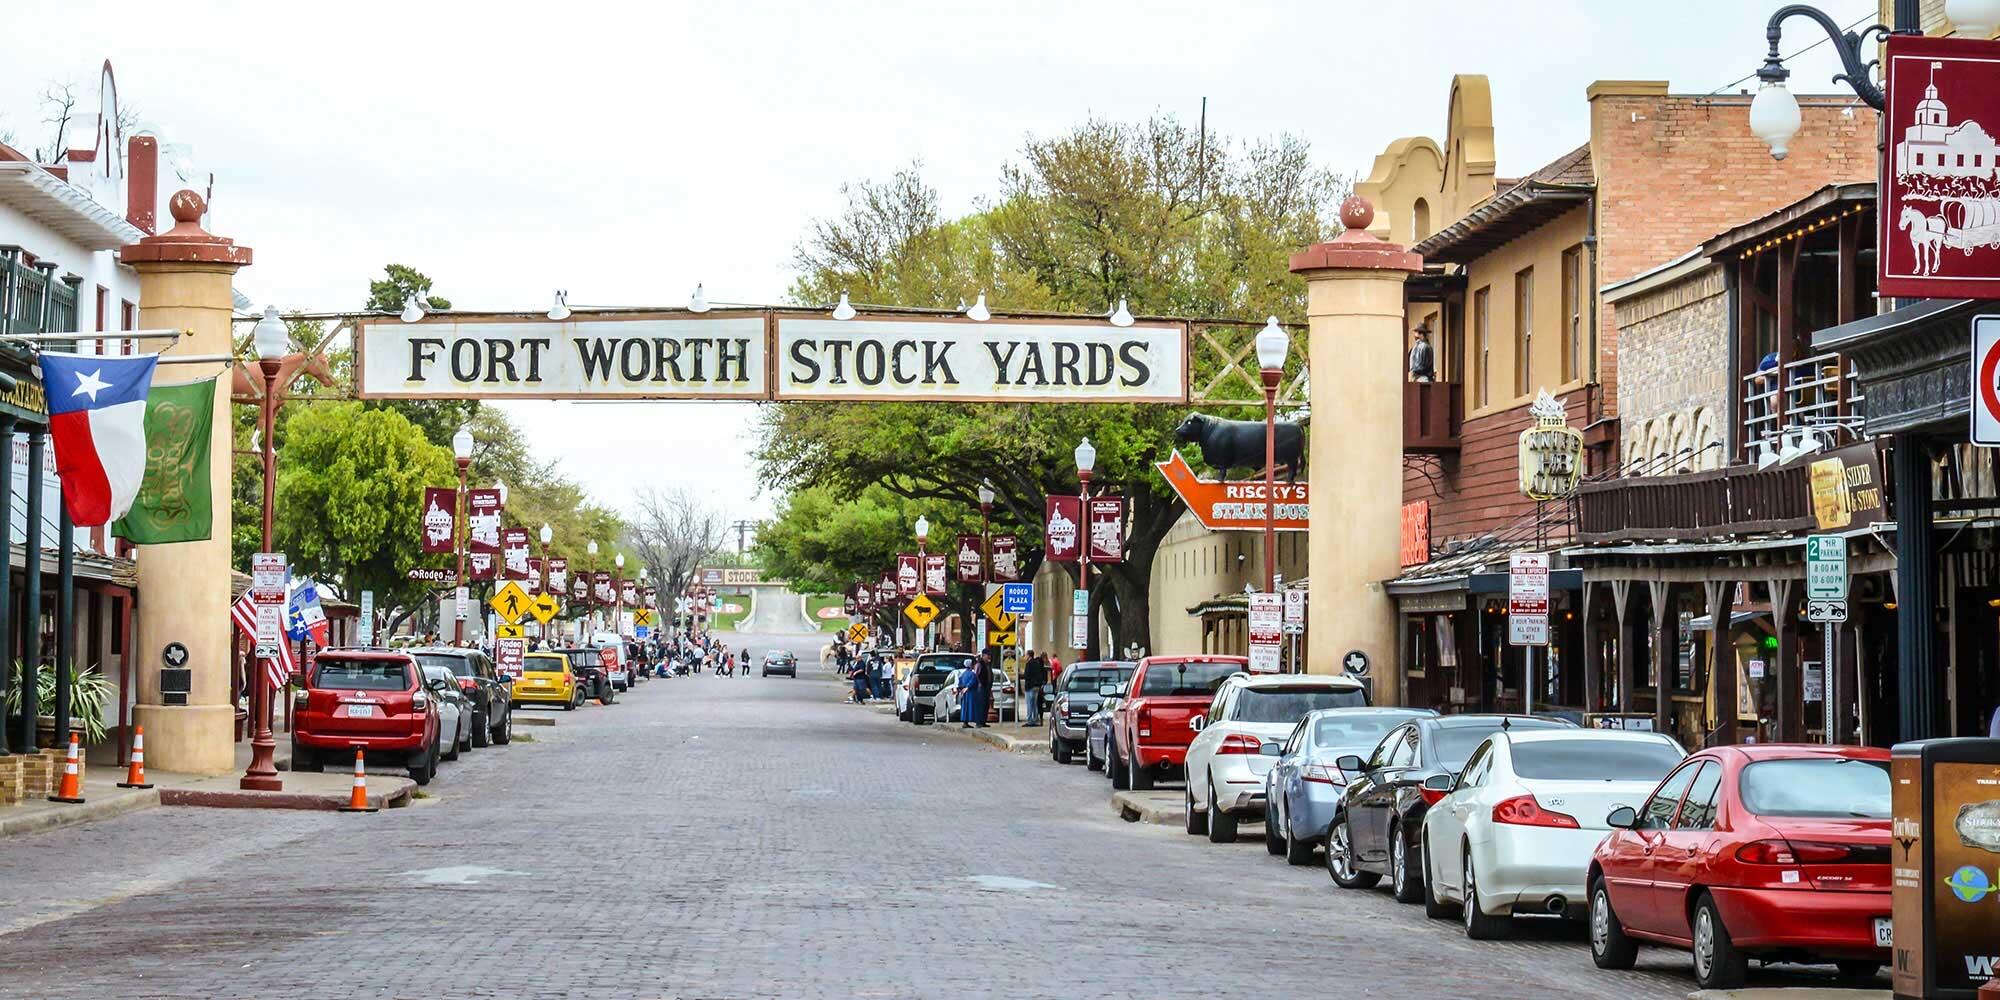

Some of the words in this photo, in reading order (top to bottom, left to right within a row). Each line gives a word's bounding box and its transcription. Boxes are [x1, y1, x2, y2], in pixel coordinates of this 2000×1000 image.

[407, 338, 550, 382] FORT
[573, 338, 750, 382] WORTH
[791, 339, 959, 384] STOCK
[983, 341, 1151, 387] YARDS
[1846, 464, 1872, 488] SILVER
[1857, 488, 1880, 511] STONE
[1809, 541, 1818, 556] 2
[1826, 539, 1836, 547] HR
[1820, 549, 1842, 558] PARKING
[419, 569, 444, 580] Rodeo
[1830, 564, 1839, 572] AM
[500, 640, 521, 648] Rodeo
[501, 647, 520, 655] Plaza
